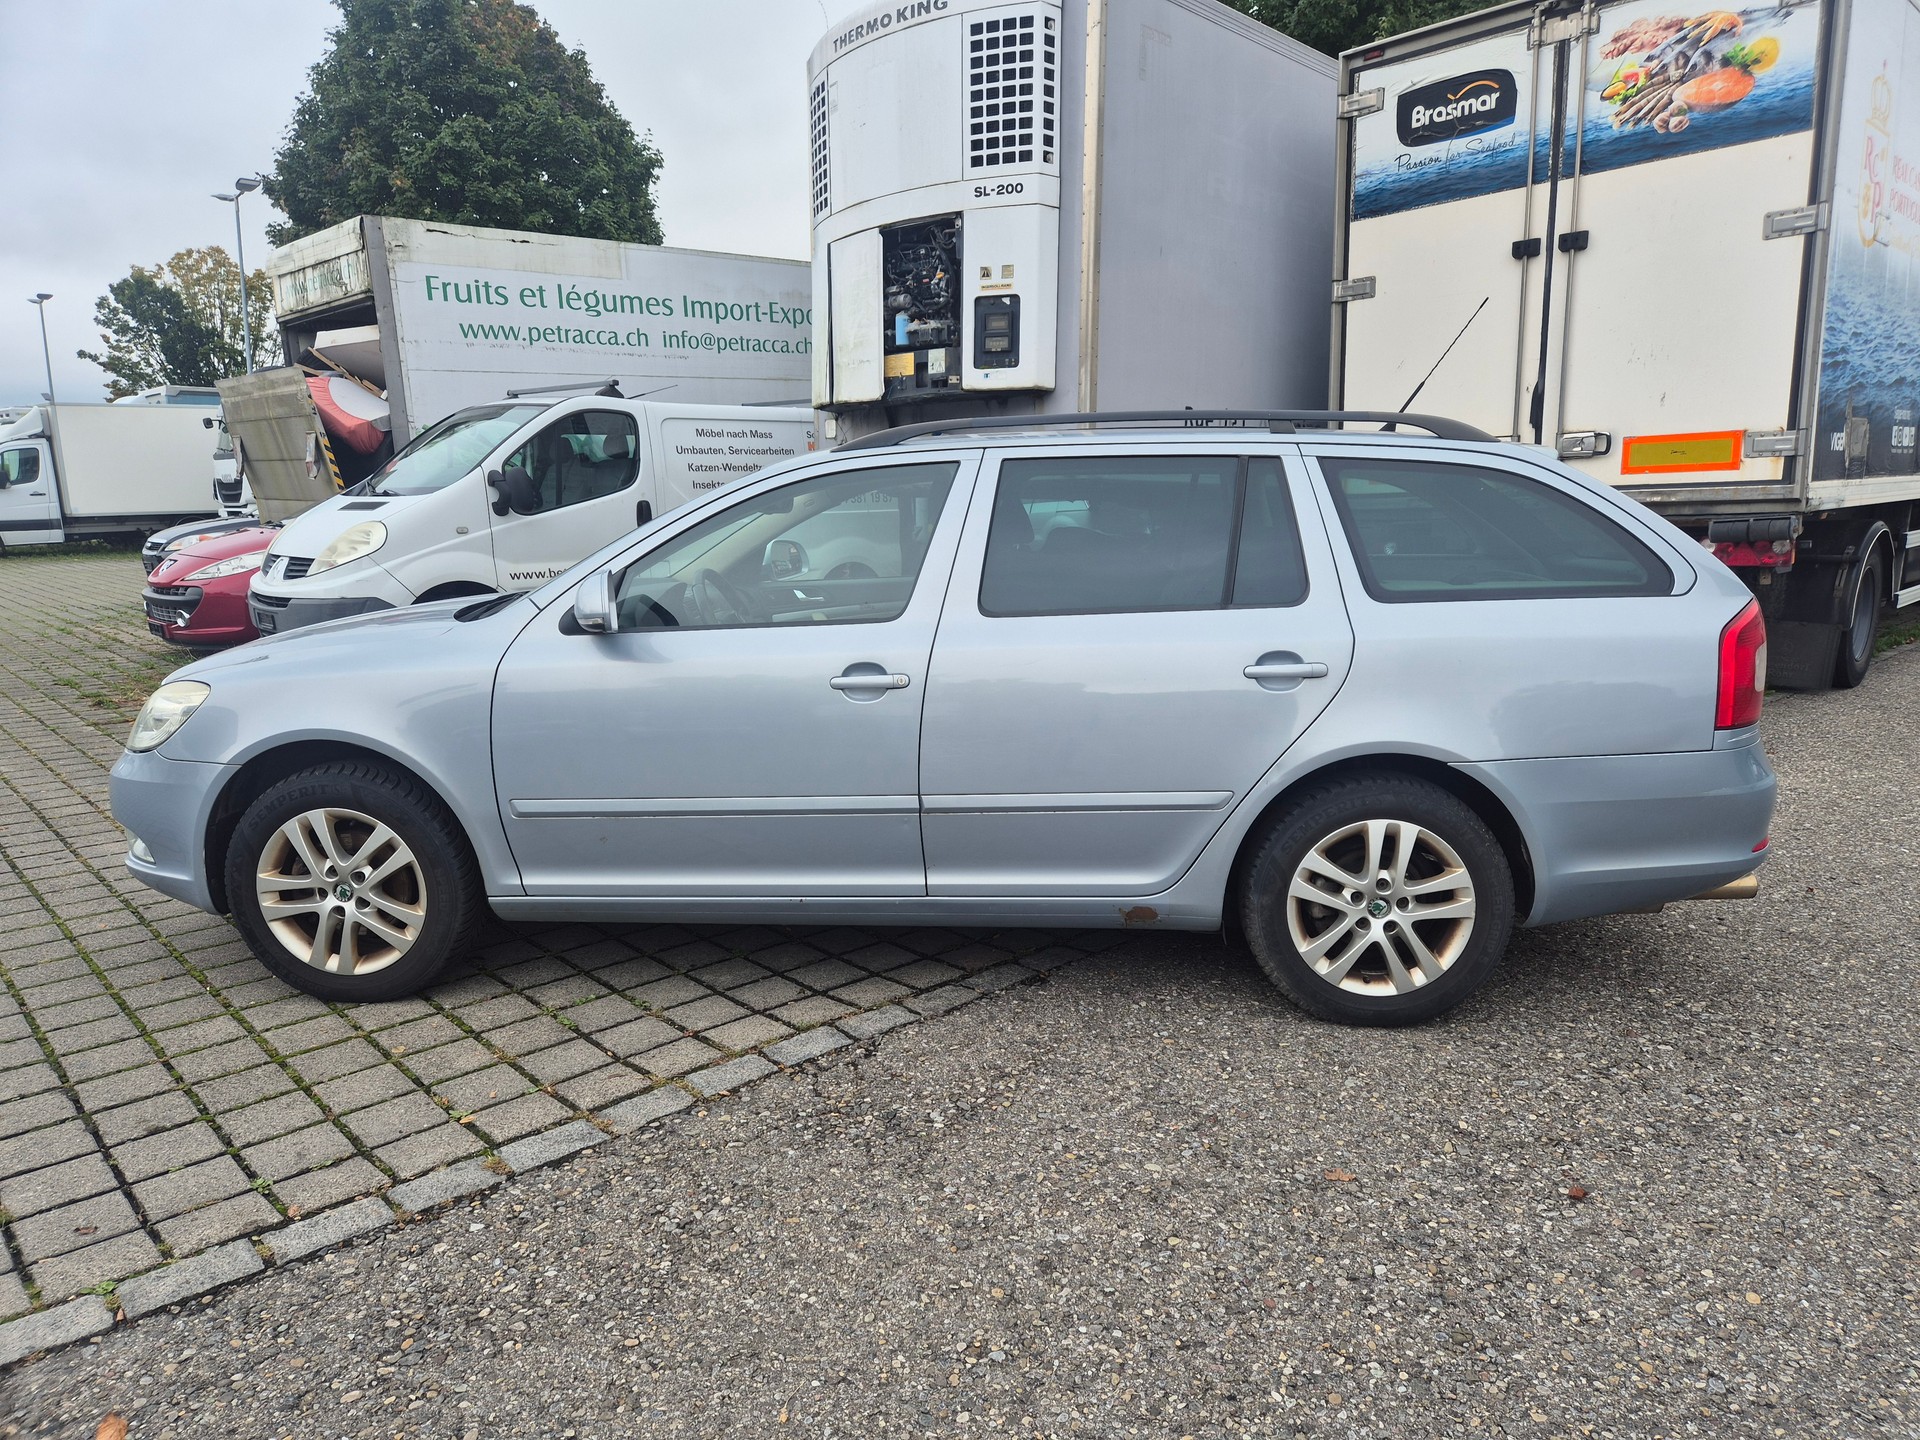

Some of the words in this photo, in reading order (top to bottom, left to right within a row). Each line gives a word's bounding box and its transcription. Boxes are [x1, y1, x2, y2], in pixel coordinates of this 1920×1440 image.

[833, 13, 892, 53] THERMO
[896, 0, 948, 24] KING
[1411, 91, 1500, 129] Brasmar
[1394, 153, 1442, 173] Passion
[1445, 142, 1462, 170] for
[1466, 133, 1516, 160] Seafood
[974, 182, 1024, 198] SL-200
[425, 275, 509, 306] Fruits
[519, 285, 548, 309] et
[557, 284, 674, 317] légumes
[459, 322, 649, 347] www.petracca.ch
[662, 330, 812, 355] info@petracca.ch
[675, 445, 727, 456] Umbauten,
[728, 446, 795, 456] Servicearbeiten
[695, 428, 725, 438] Möbel
[726, 429, 748, 438] nach
[750, 430, 773, 439] Mass
